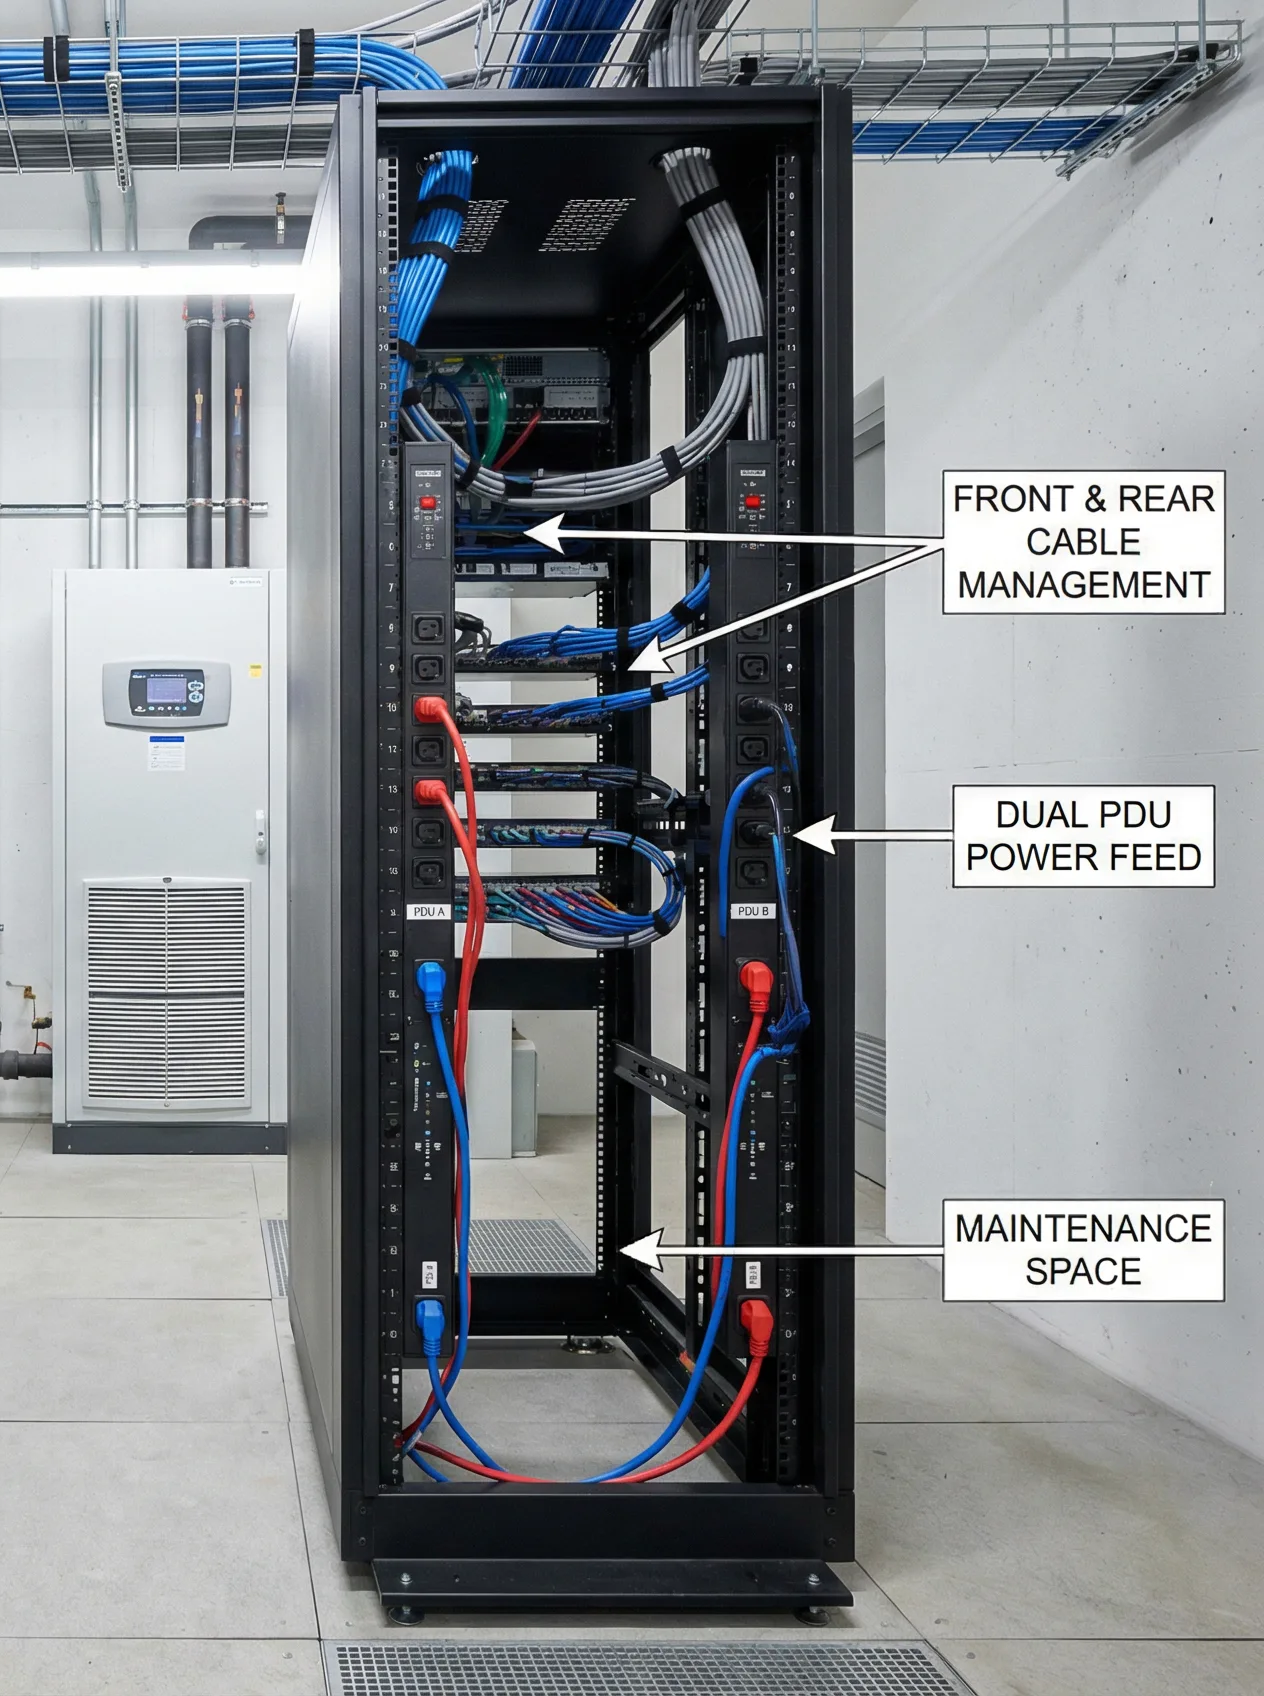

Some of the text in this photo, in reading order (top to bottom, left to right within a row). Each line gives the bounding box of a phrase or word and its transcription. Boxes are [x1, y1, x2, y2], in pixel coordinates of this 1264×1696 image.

[414, 907, 445, 917] PDU A
[738, 906, 769, 916] PDU B
